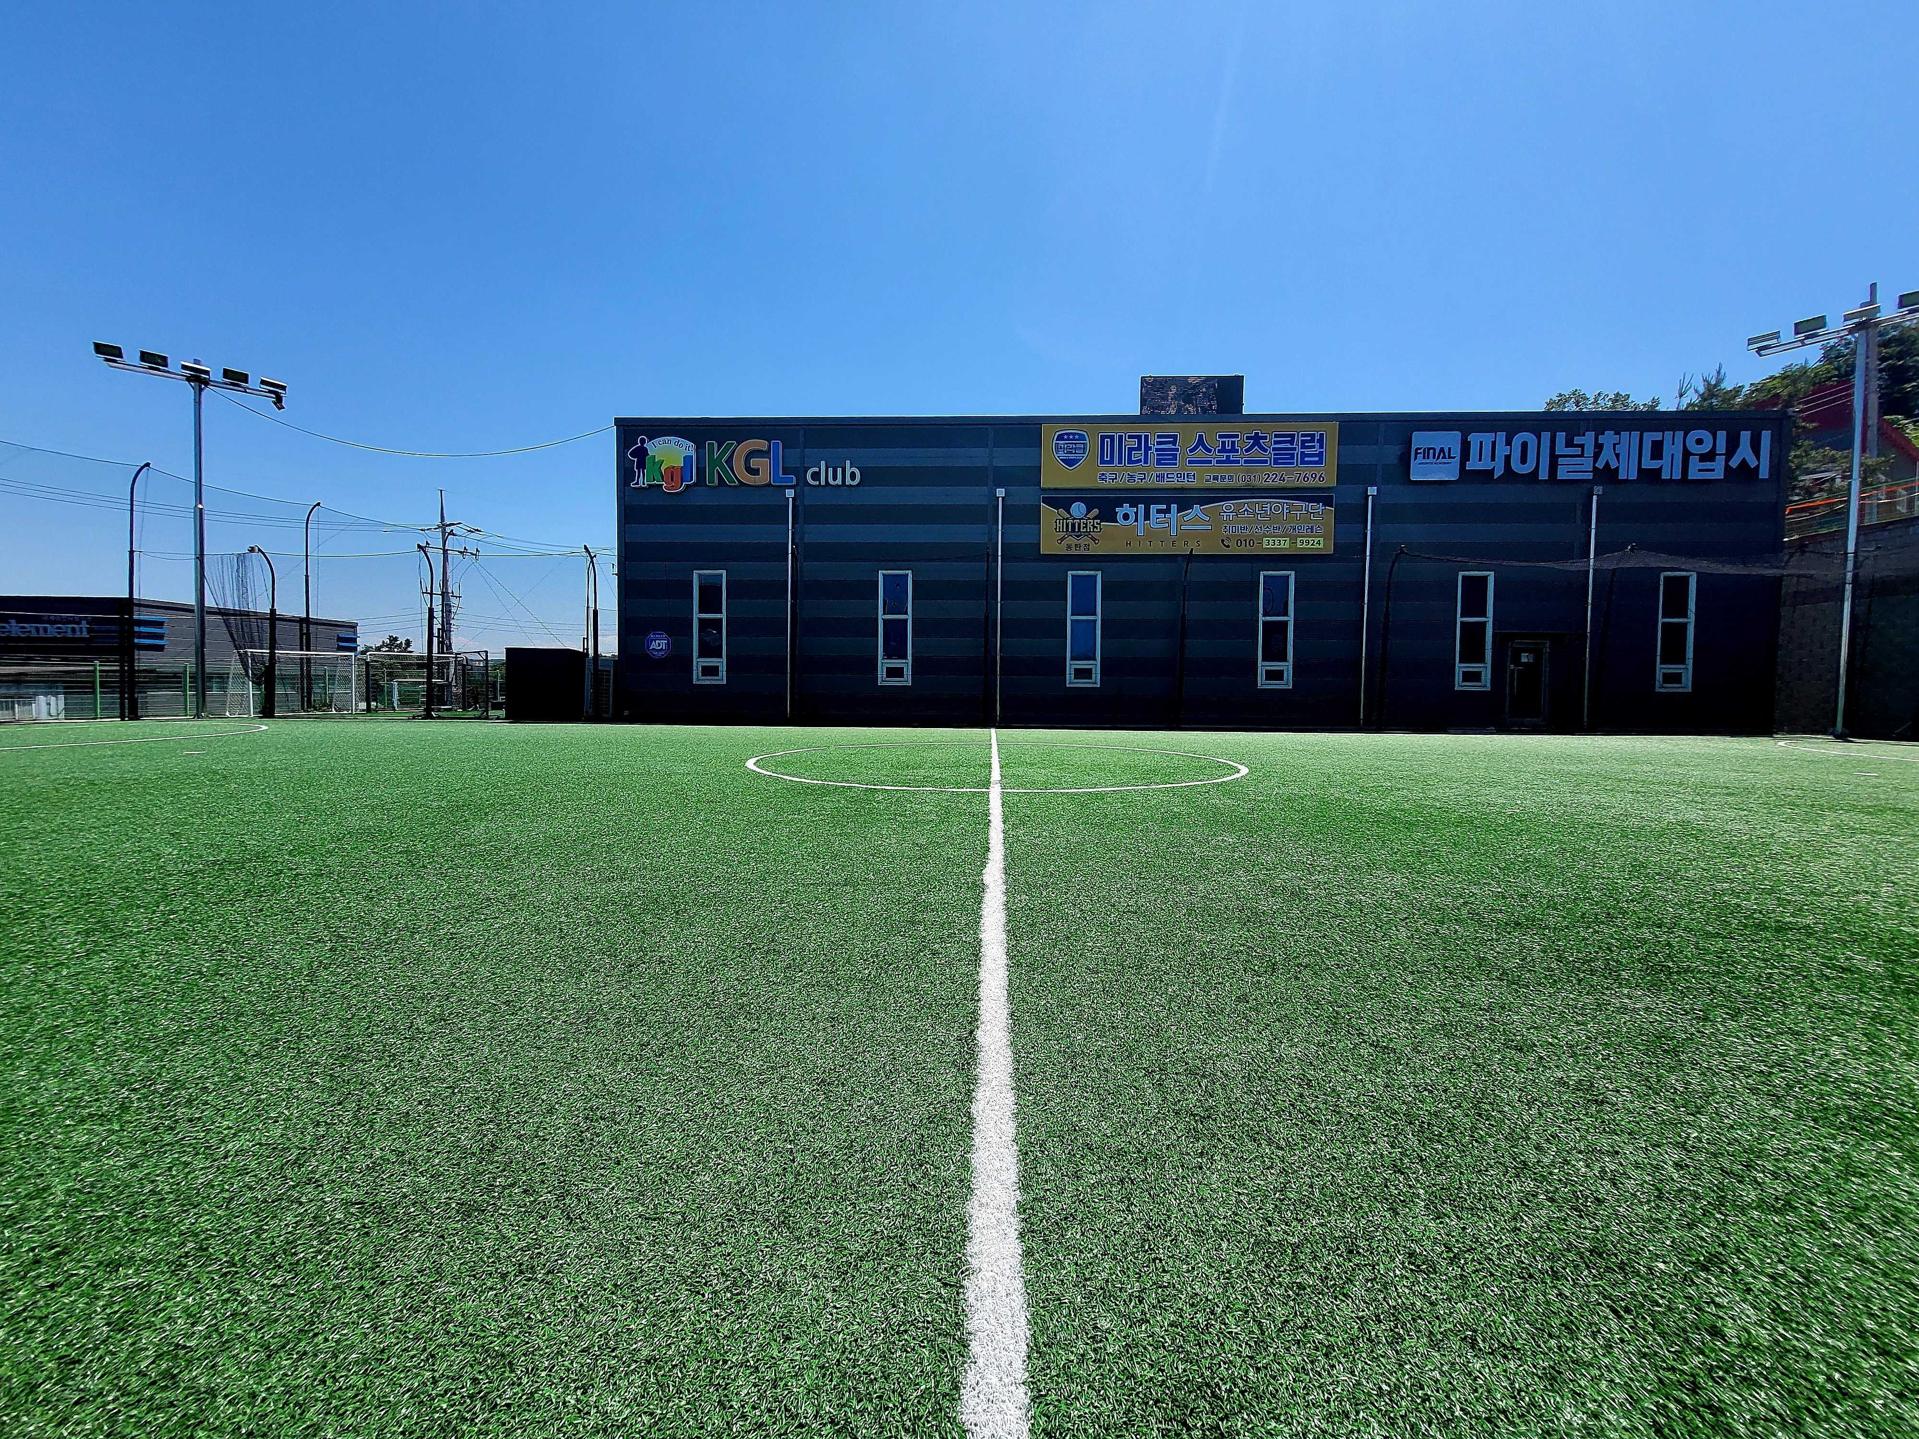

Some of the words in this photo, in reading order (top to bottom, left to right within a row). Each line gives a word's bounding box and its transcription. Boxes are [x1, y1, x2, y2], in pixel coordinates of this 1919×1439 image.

[673, 440, 684, 449] do
[1097, 432, 1181, 468] 미라클
[1186, 430, 1327, 468] 스포츠클럽
[1413, 446, 1457, 462] FINAL
[1466, 429, 1772, 481] 파이널체대입시
[705, 439, 796, 486] KGL
[806, 460, 861, 486] club
[1263, 472, 1326, 484] 224-7696
[1056, 519, 1101, 532] HITTERS
[1115, 503, 1212, 537] 히터스
[1220, 502, 1325, 521] 유소년야구단
[1125, 540, 1201, 548] HITTERS
[649, 640, 668, 650] ADT
